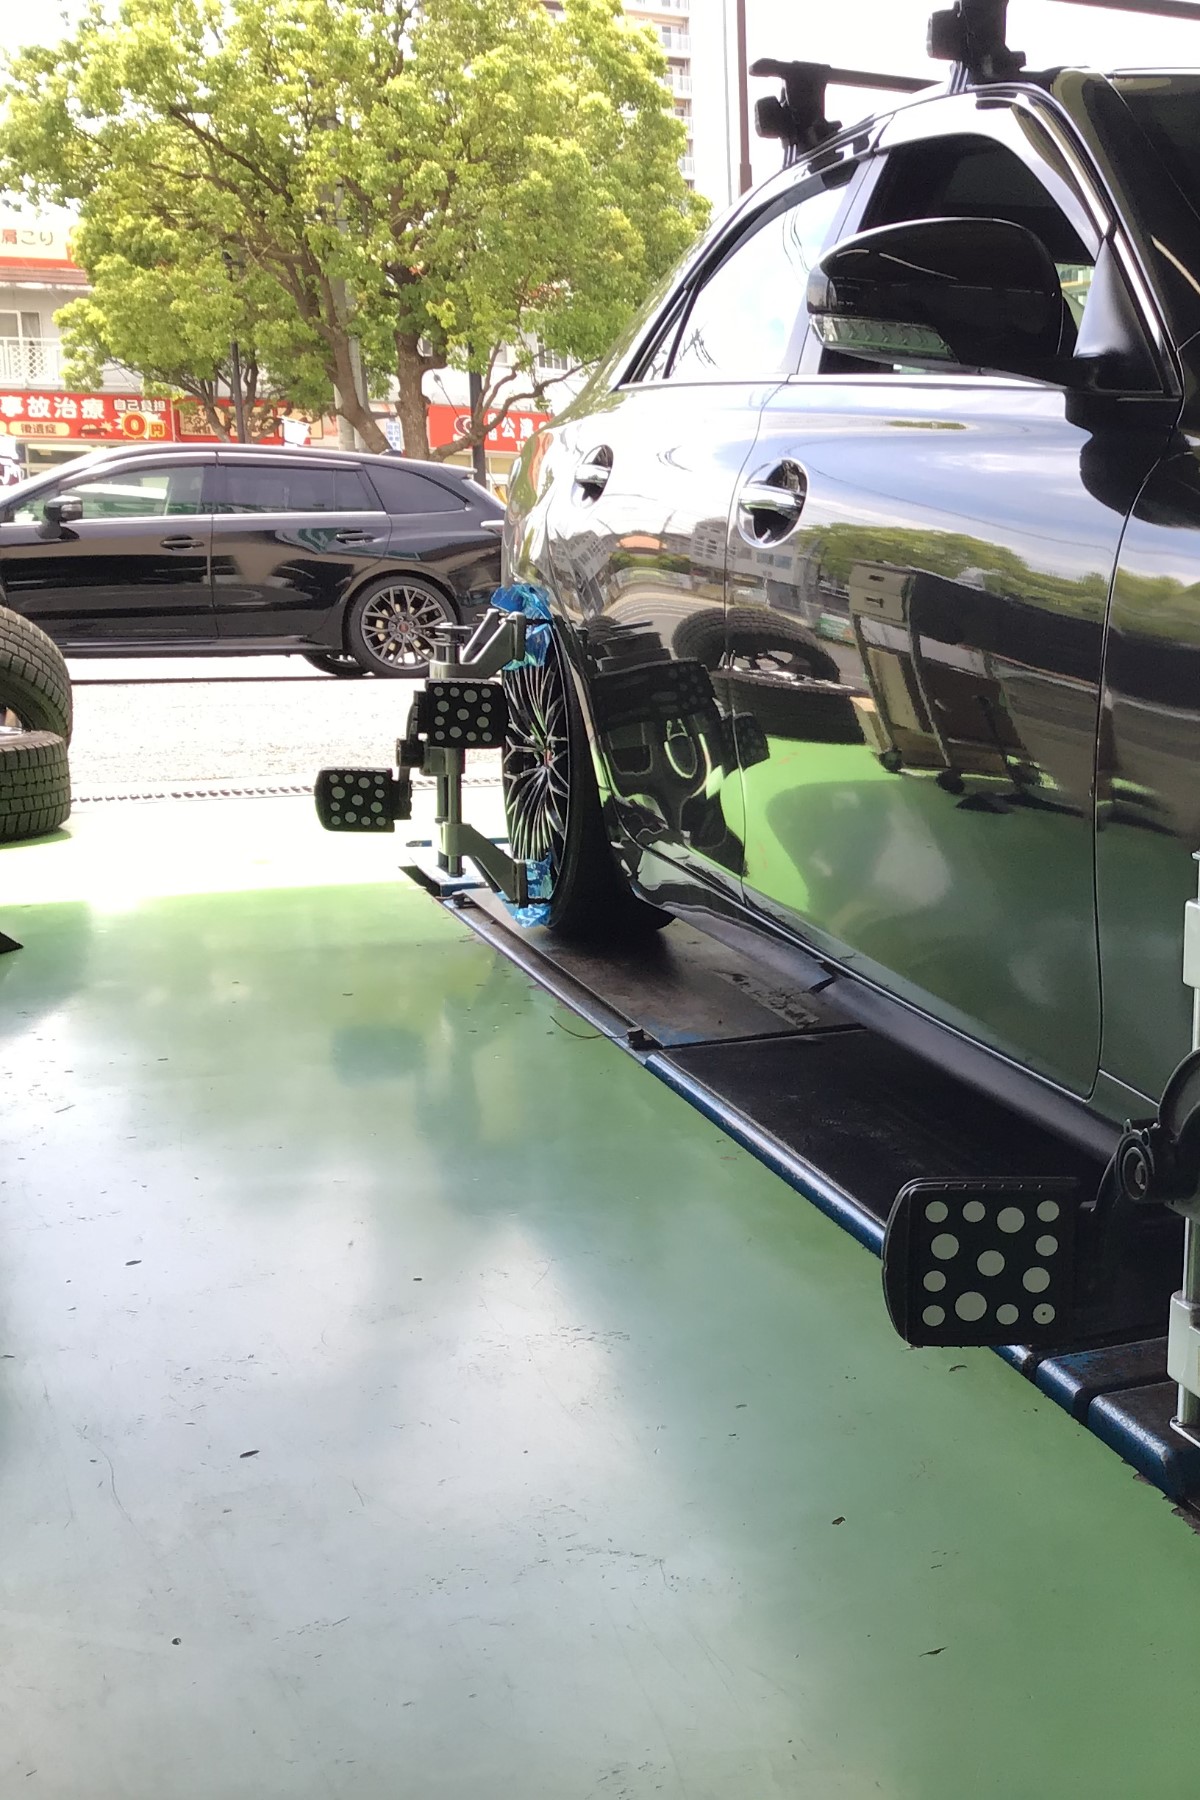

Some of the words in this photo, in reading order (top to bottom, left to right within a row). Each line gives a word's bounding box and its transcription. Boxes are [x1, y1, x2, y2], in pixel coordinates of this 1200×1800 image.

[0, 395, 104, 419] 事故治療
[113, 399, 166, 412] 自己負担
